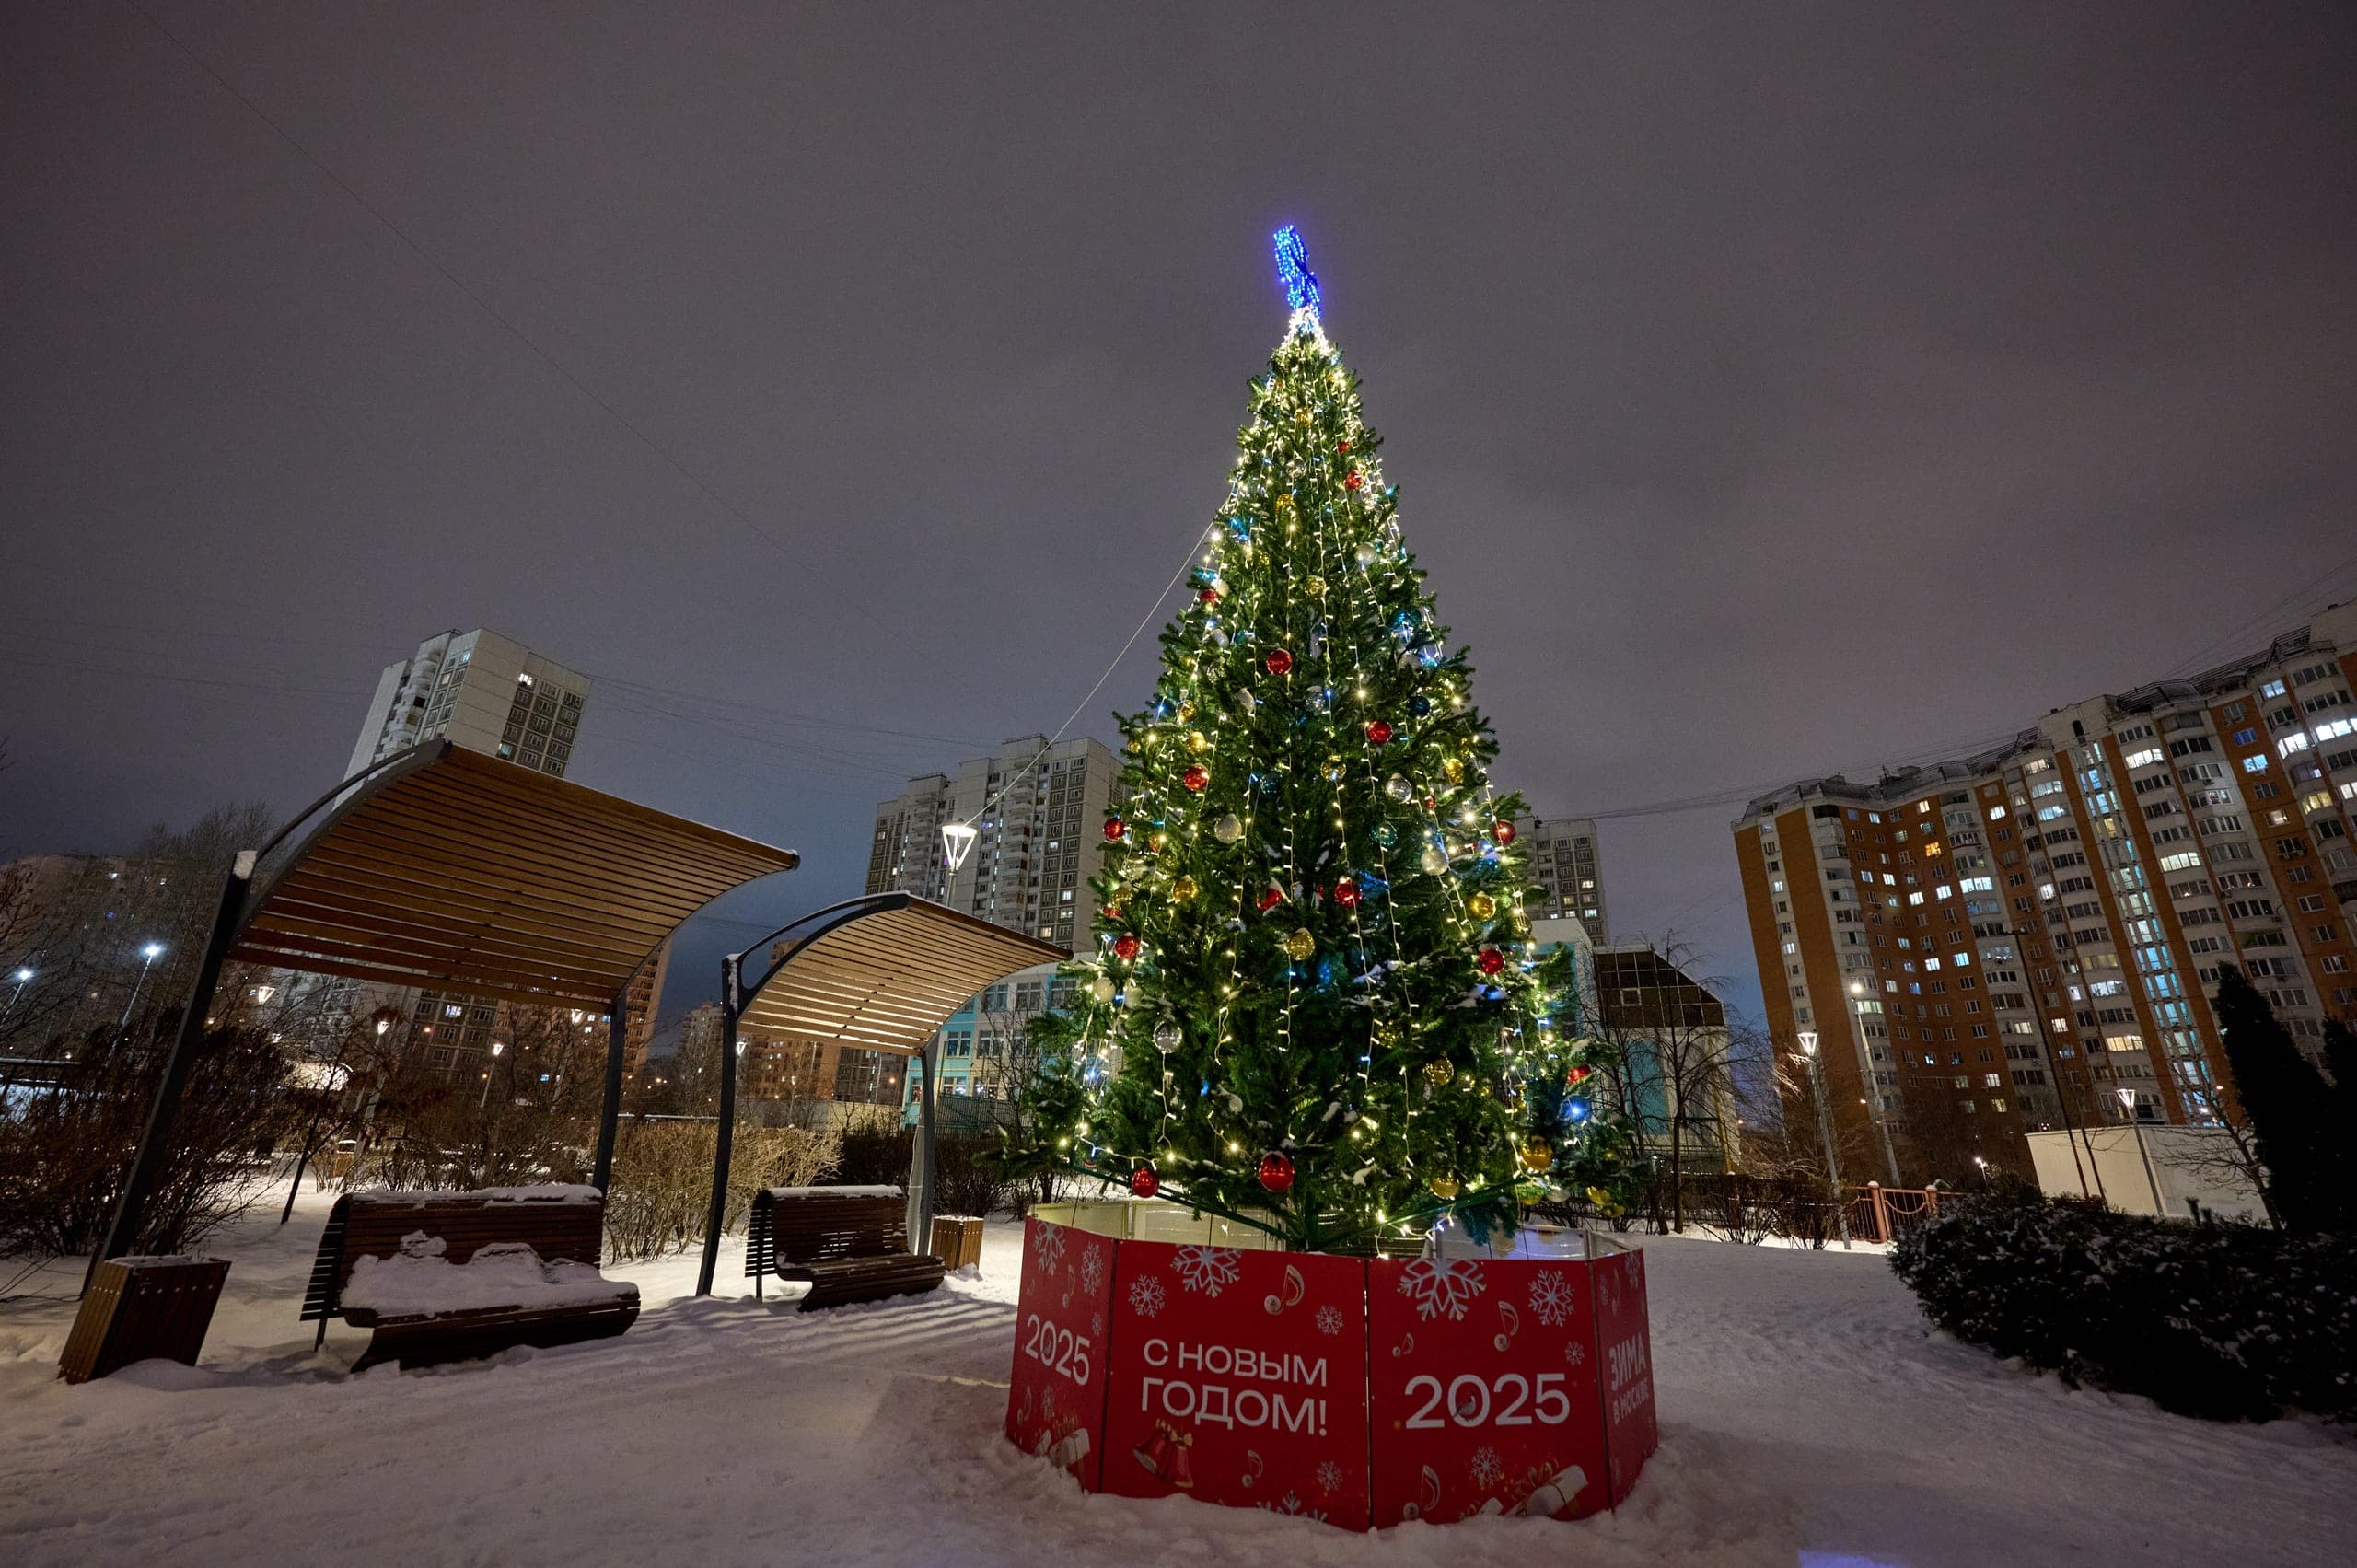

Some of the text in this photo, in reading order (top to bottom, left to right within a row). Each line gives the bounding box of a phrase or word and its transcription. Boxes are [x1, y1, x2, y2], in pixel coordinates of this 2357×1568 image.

[1025, 1314, 1090, 1386] 2025
[1144, 1339, 1327, 1387] С НОВЫМ
[1609, 1332, 1646, 1391] ЗИМА
[1142, 1377, 1327, 1436] ГОДОМ!
[1405, 1373, 1570, 1429] 2025
